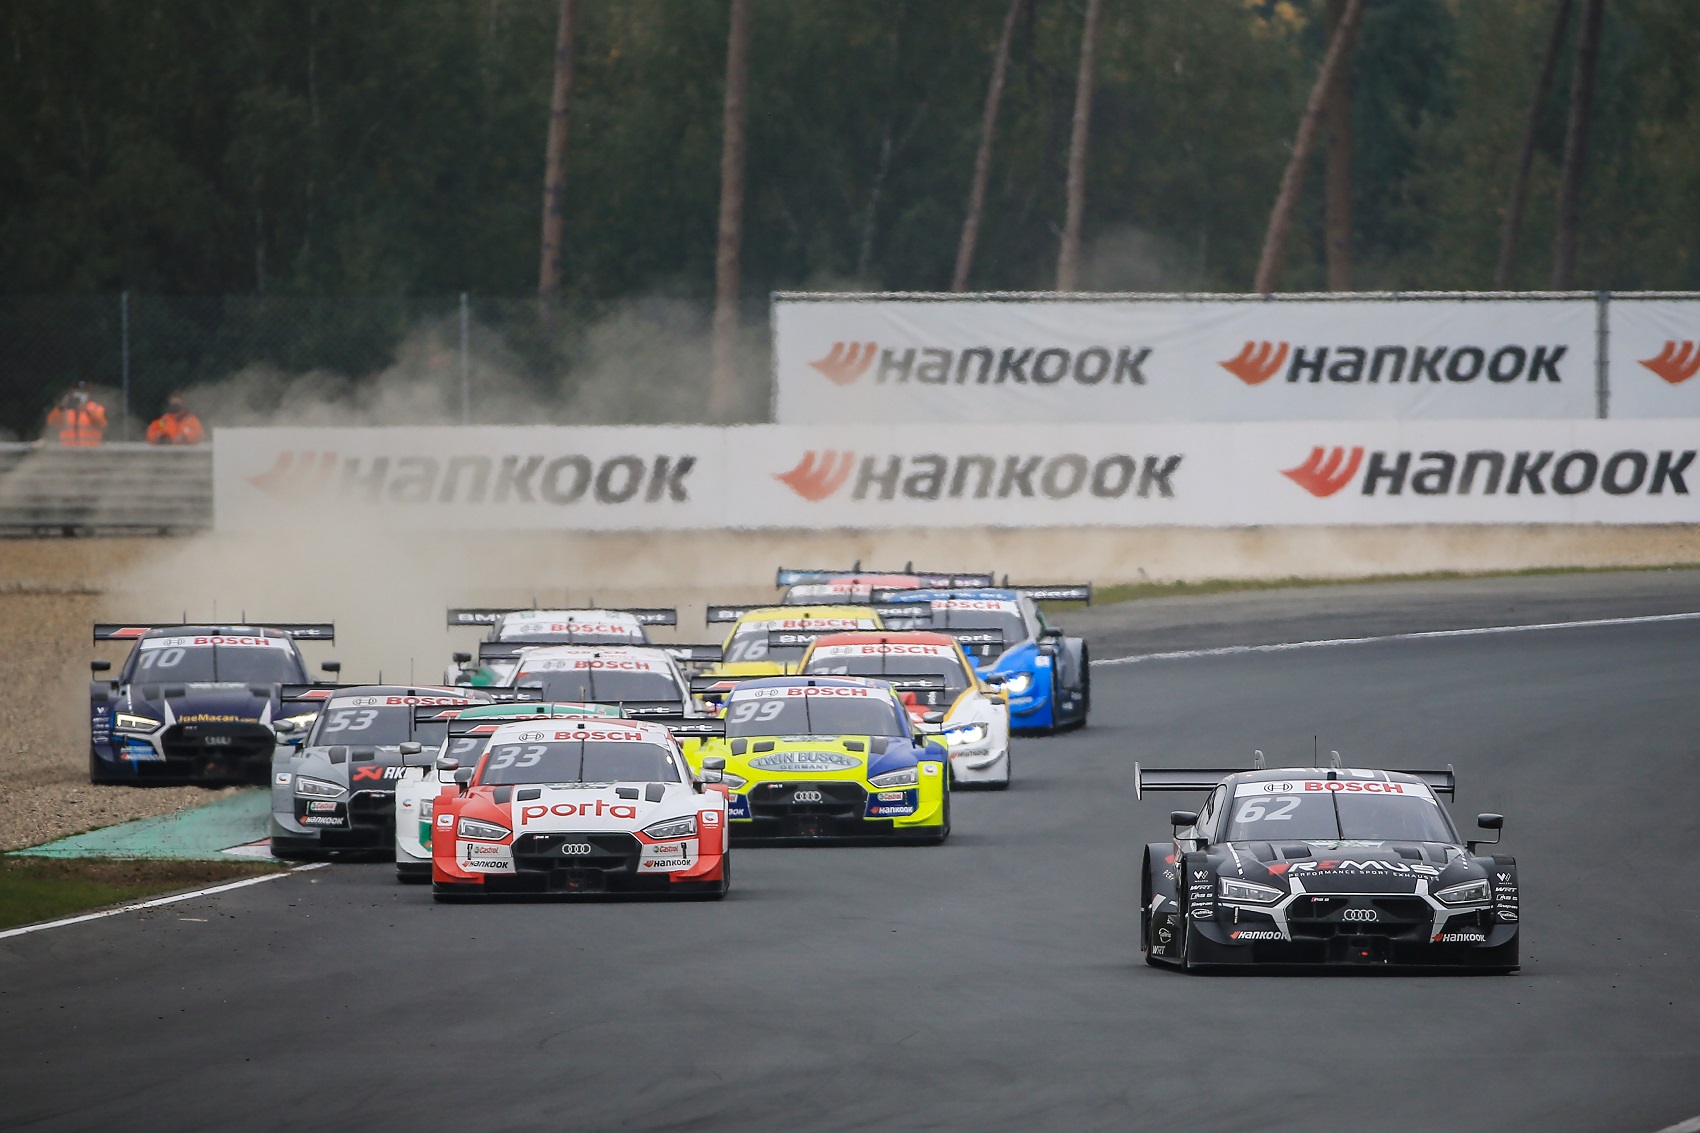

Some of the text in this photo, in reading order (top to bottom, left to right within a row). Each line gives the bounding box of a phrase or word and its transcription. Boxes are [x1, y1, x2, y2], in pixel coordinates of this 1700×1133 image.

[551, 623, 625, 634] BOSCH
[783, 619, 857, 629] BOSCH
[194, 636, 270, 646] BOSCH
[729, 639, 768, 663] 16
[862, 645, 938, 656] BOSCH
[138, 648, 186, 669] 10
[573, 660, 650, 671] BOSCH
[788, 687, 868, 697] BOSCH
[386, 696, 468, 706] BOSCH
[730, 701, 785, 724] 99
[325, 710, 378, 732] 53
[554, 731, 643, 742] BOSCH
[489, 745, 548, 770] 33
[757, 751, 852, 767] TWIN BUSCH
[1304, 781, 1404, 794] BOSCH
[521, 799, 636, 826] porta
[1235, 796, 1302, 824] 62
[1287, 859, 1440, 877] REMUS
[1288, 869, 1355, 878] PERFORMANCE
[1392, 871, 1440, 882] EXHAUSTS
